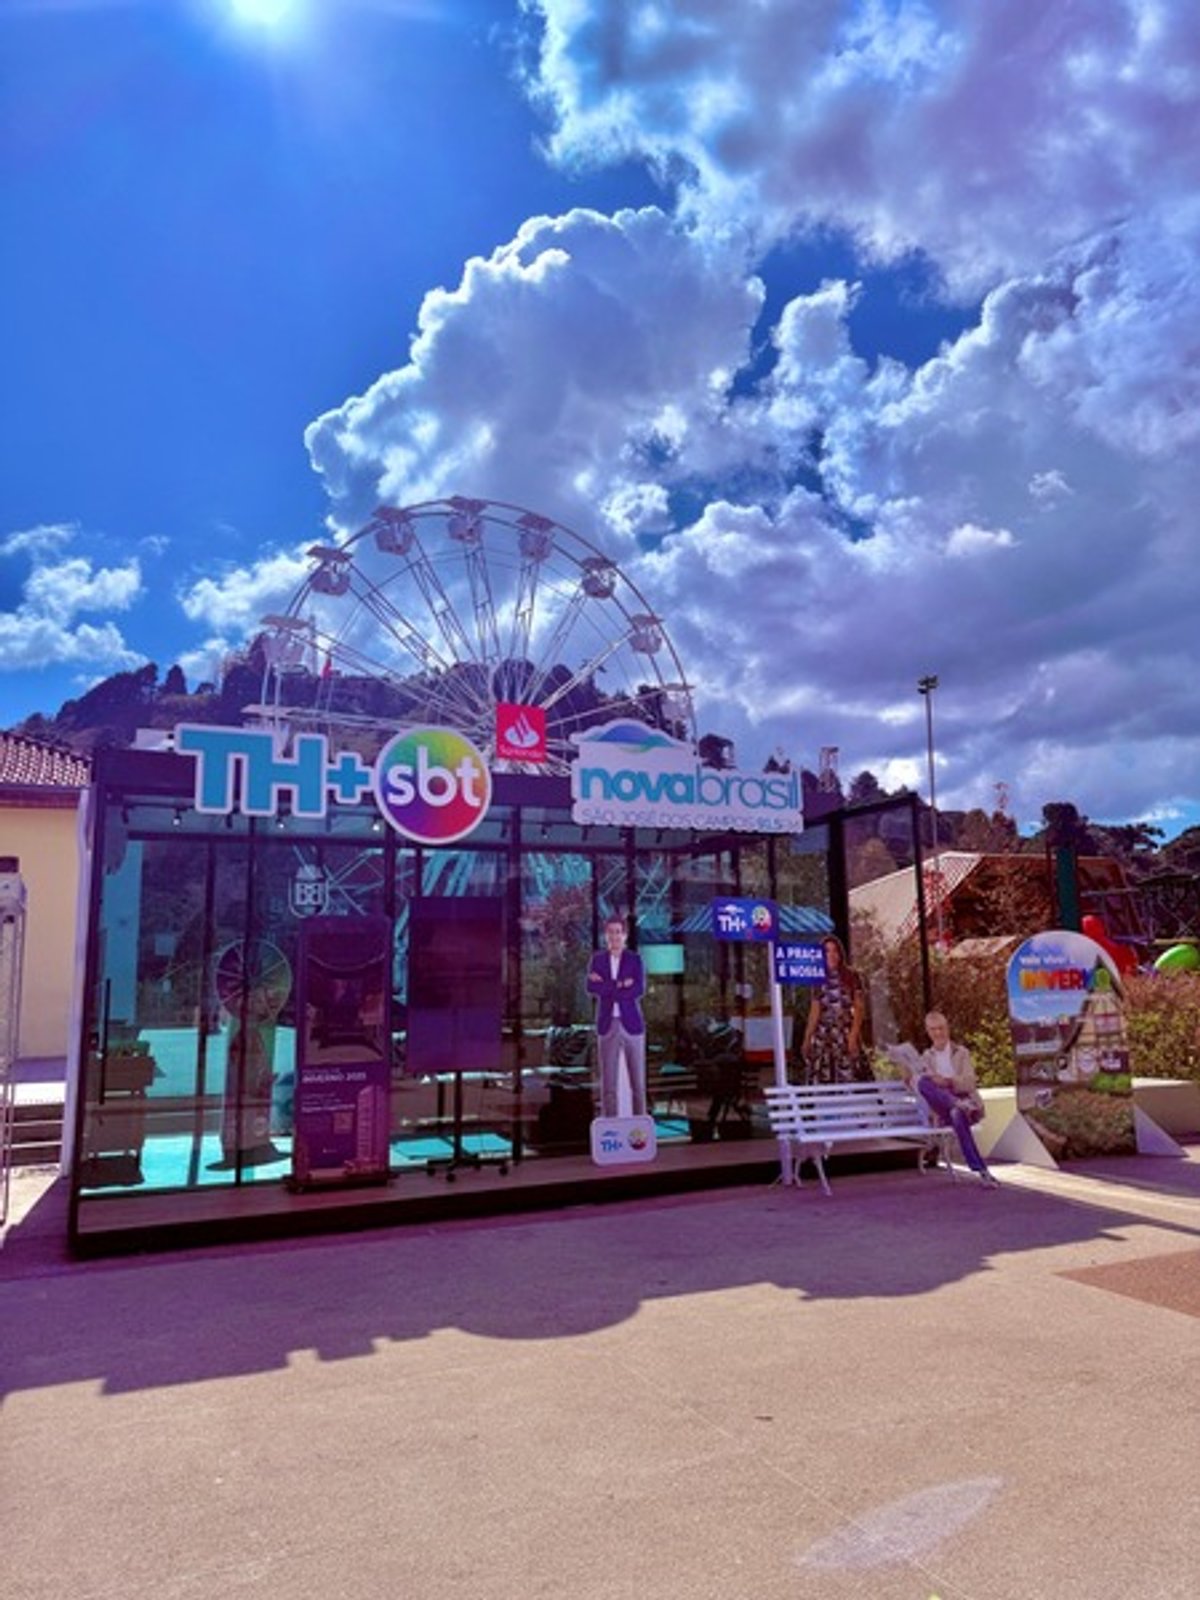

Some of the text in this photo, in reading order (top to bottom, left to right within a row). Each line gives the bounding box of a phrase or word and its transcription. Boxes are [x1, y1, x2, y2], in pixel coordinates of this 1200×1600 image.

[176, 724, 373, 817] TH+
[386, 745, 482, 808] sbt
[776, 946, 823, 963] A PRAÇA
[778, 962, 826, 978] É NOSSA
